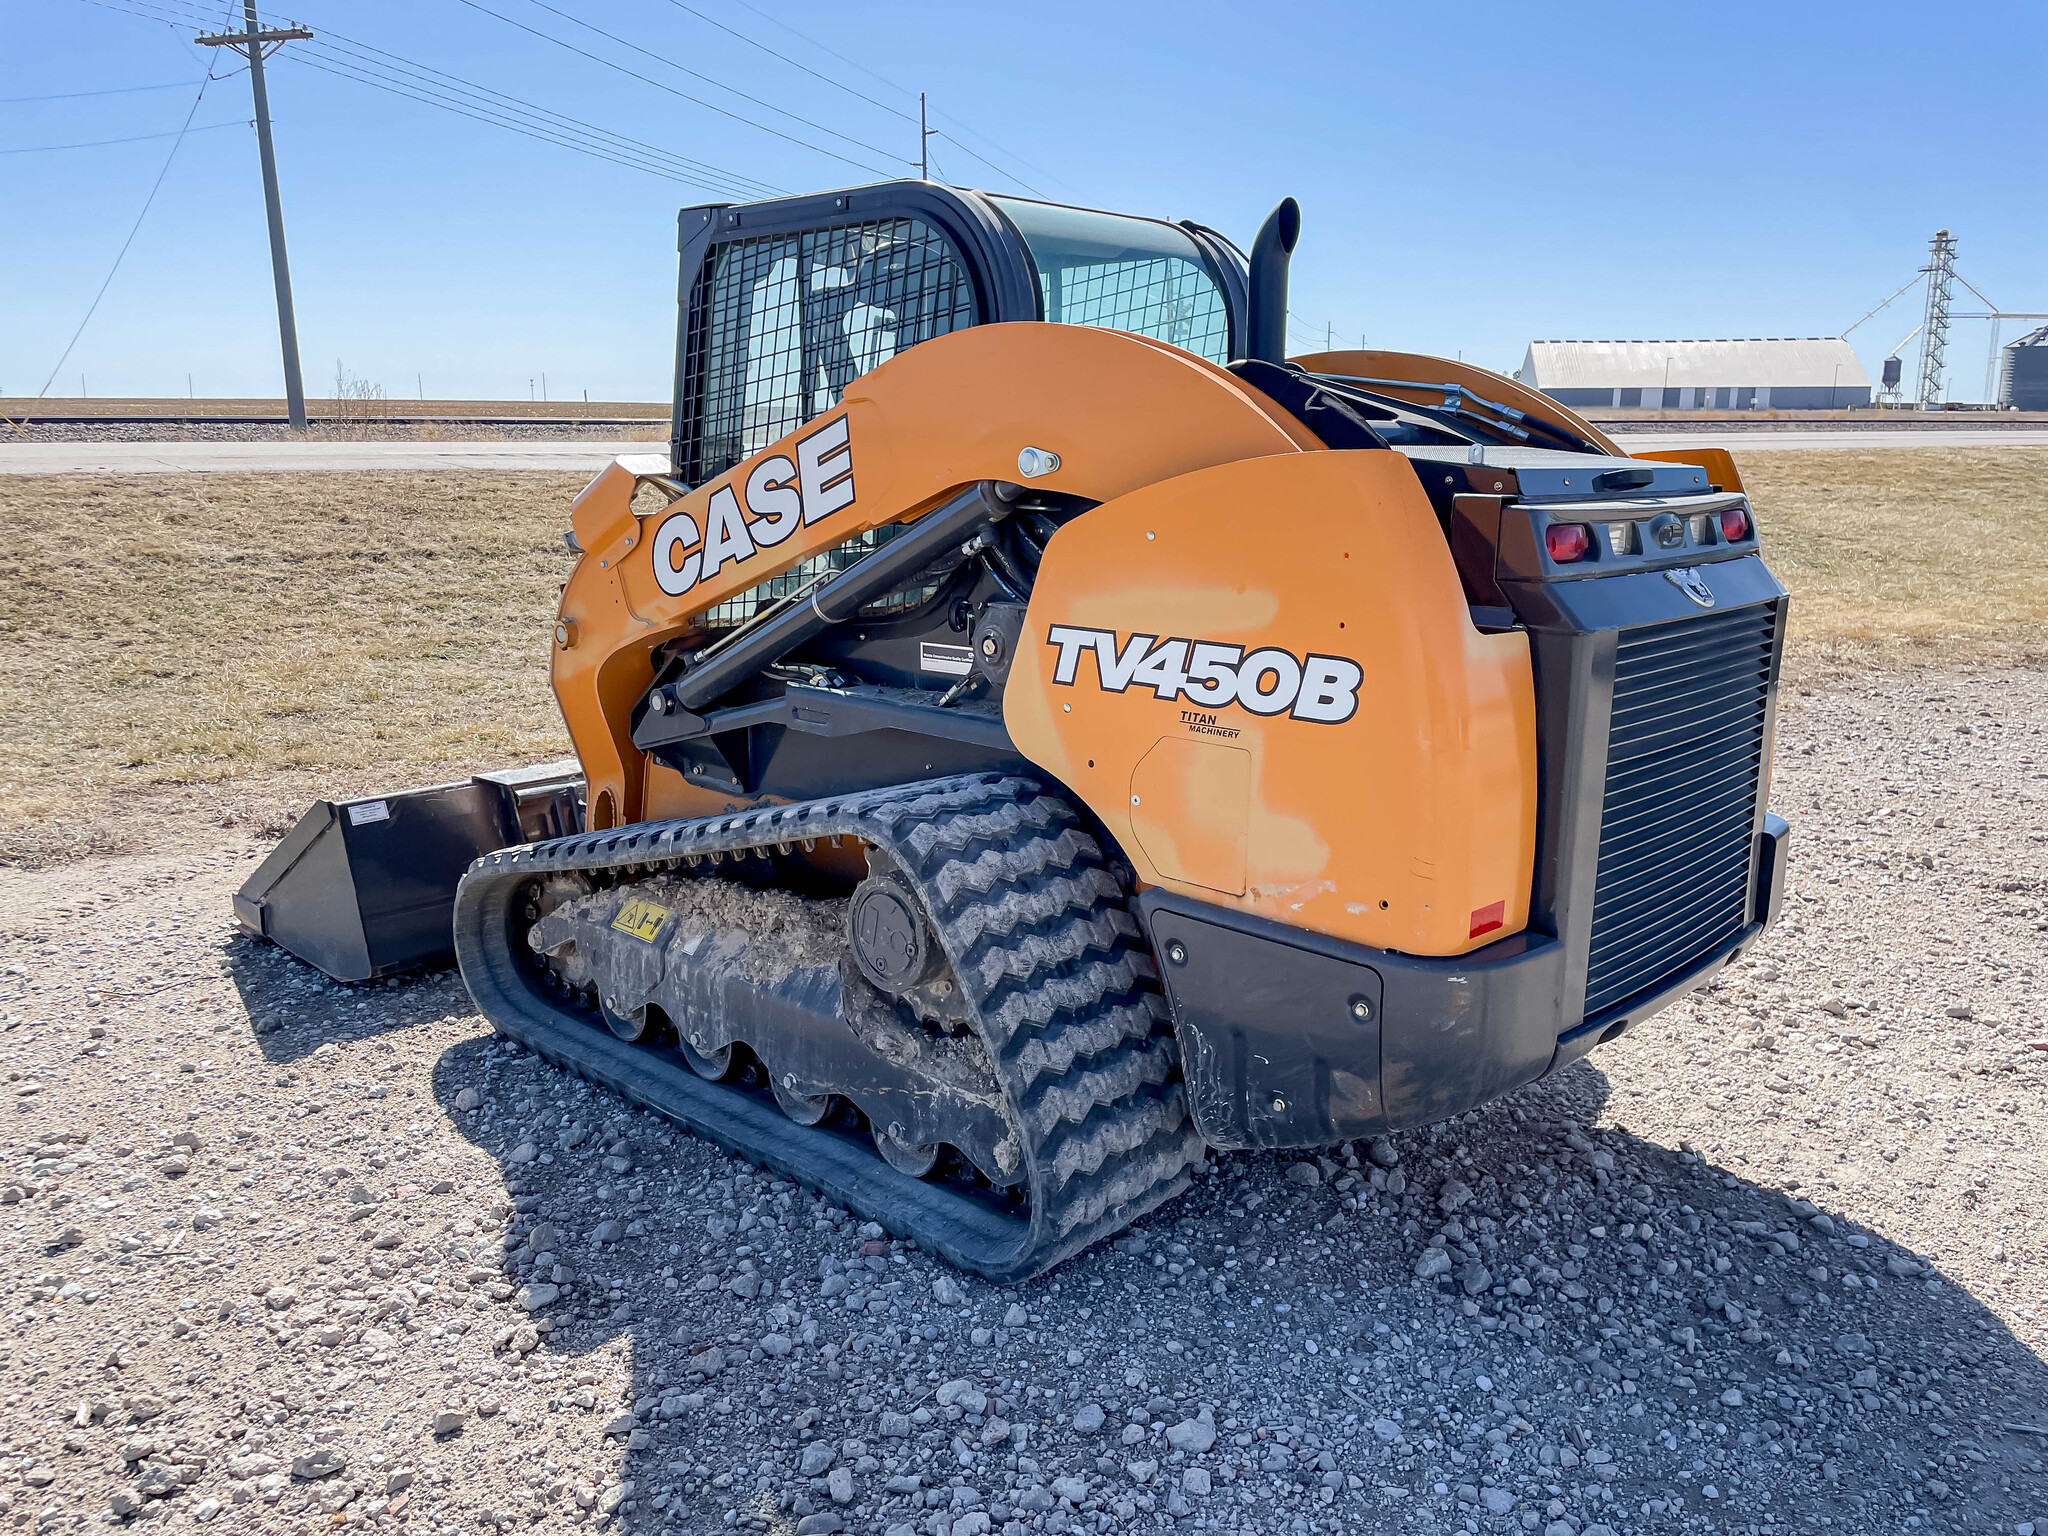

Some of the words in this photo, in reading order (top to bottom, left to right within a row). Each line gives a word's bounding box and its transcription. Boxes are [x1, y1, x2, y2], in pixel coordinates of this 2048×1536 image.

[652, 413, 856, 597] CASE
[1046, 624, 1364, 725] TV450B
[1181, 710, 1217, 725] TITAN
[1188, 725, 1240, 739] MACHINERY
